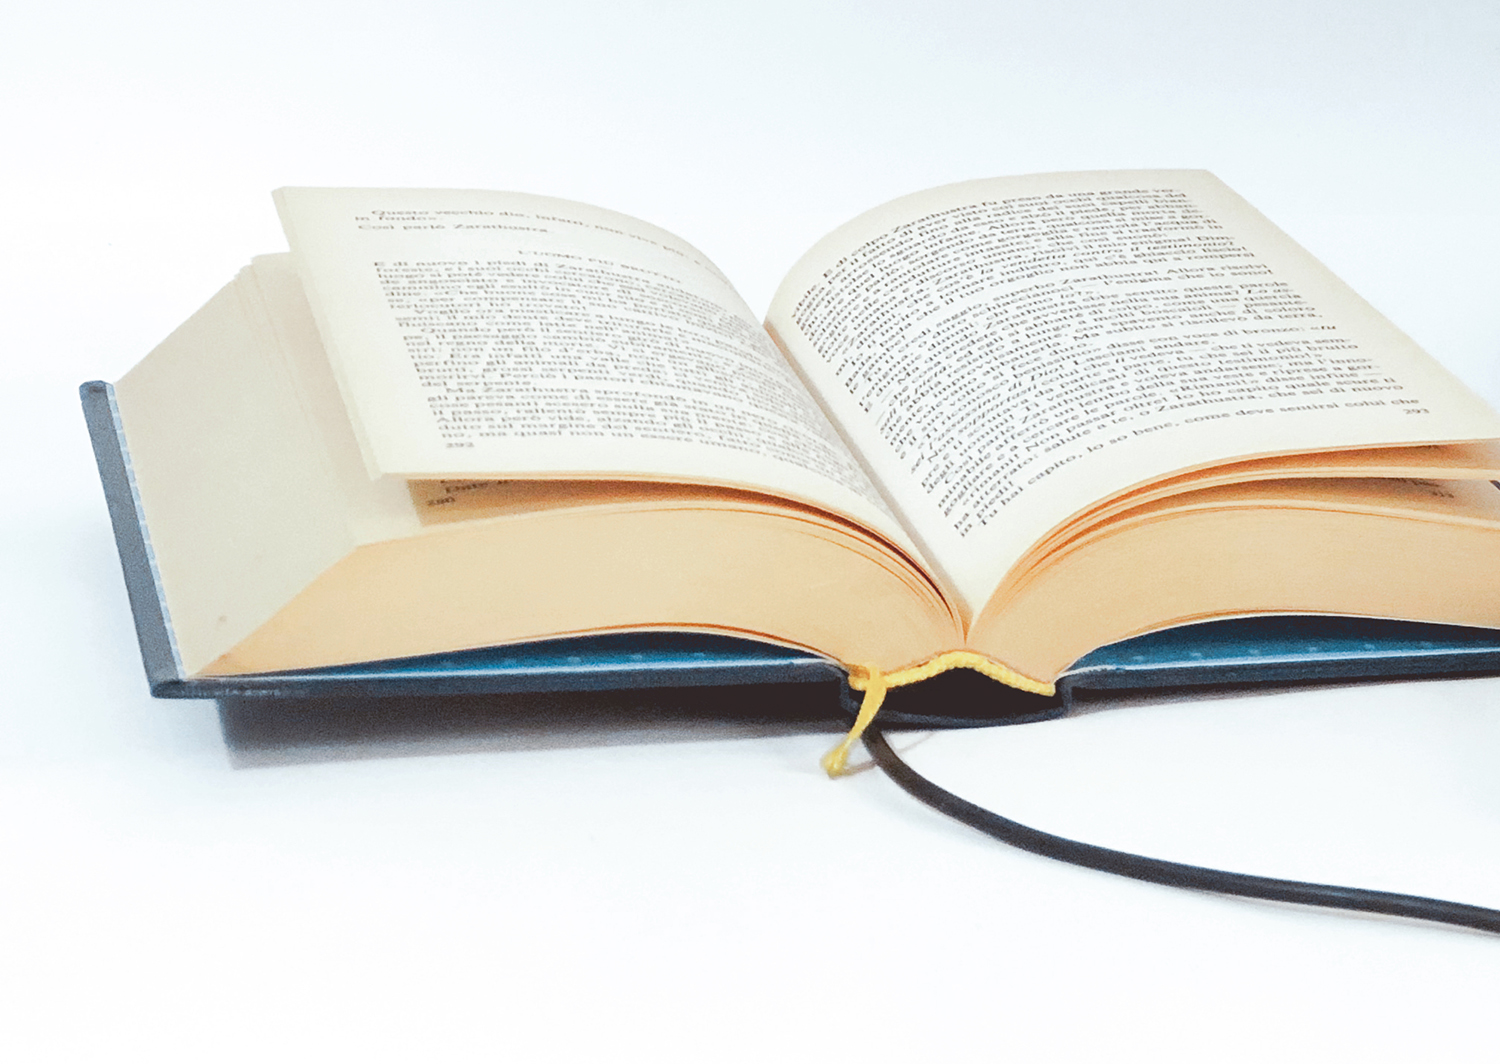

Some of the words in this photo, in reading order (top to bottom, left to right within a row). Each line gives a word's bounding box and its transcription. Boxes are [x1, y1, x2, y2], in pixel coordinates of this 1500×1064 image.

[897, 327, 932, 354] credi
[992, 282, 1056, 304] superbo
[1166, 267, 1216, 275] Allora
[1219, 263, 1268, 271] risolvi
[906, 293, 931, 309] che
[936, 274, 974, 293] cos'è
[1001, 253, 1066, 269] vendetta
[1072, 248, 1124, 257] contro
[1074, 324, 1104, 334] con
[1110, 315, 1183, 327] spavento
[1189, 310, 1236, 319] anche
[1263, 306, 1316, 314] coloro
[894, 428, 913, 453] che
[915, 377, 978, 425] volevano
[1105, 324, 1156, 335] subito
[1179, 316, 1248, 326] risollevò
[911, 452, 925, 474] sei
[928, 392, 1002, 451] l'assassino
[1072, 346, 1147, 366] Lasciami
[926, 460, 955, 495] degli
[1046, 372, 1127, 402] vendicasti
[1157, 361, 1212, 373] questo
[944, 455, 974, 485] Così
[977, 425, 1016, 455] parlò
[1019, 384, 1116, 425] Zarathustra
[1133, 371, 1189, 384] voleva
[1044, 429, 1091, 453] salute
[1301, 387, 1324, 396] sei
[1351, 385, 1404, 393] nuovo
[1000, 486, 1024, 506] hai
[1184, 412, 1231, 424] come
[1234, 408, 1275, 416] deve
[1279, 402, 1340, 413] sentirsi
[1344, 399, 1386, 408] colui
